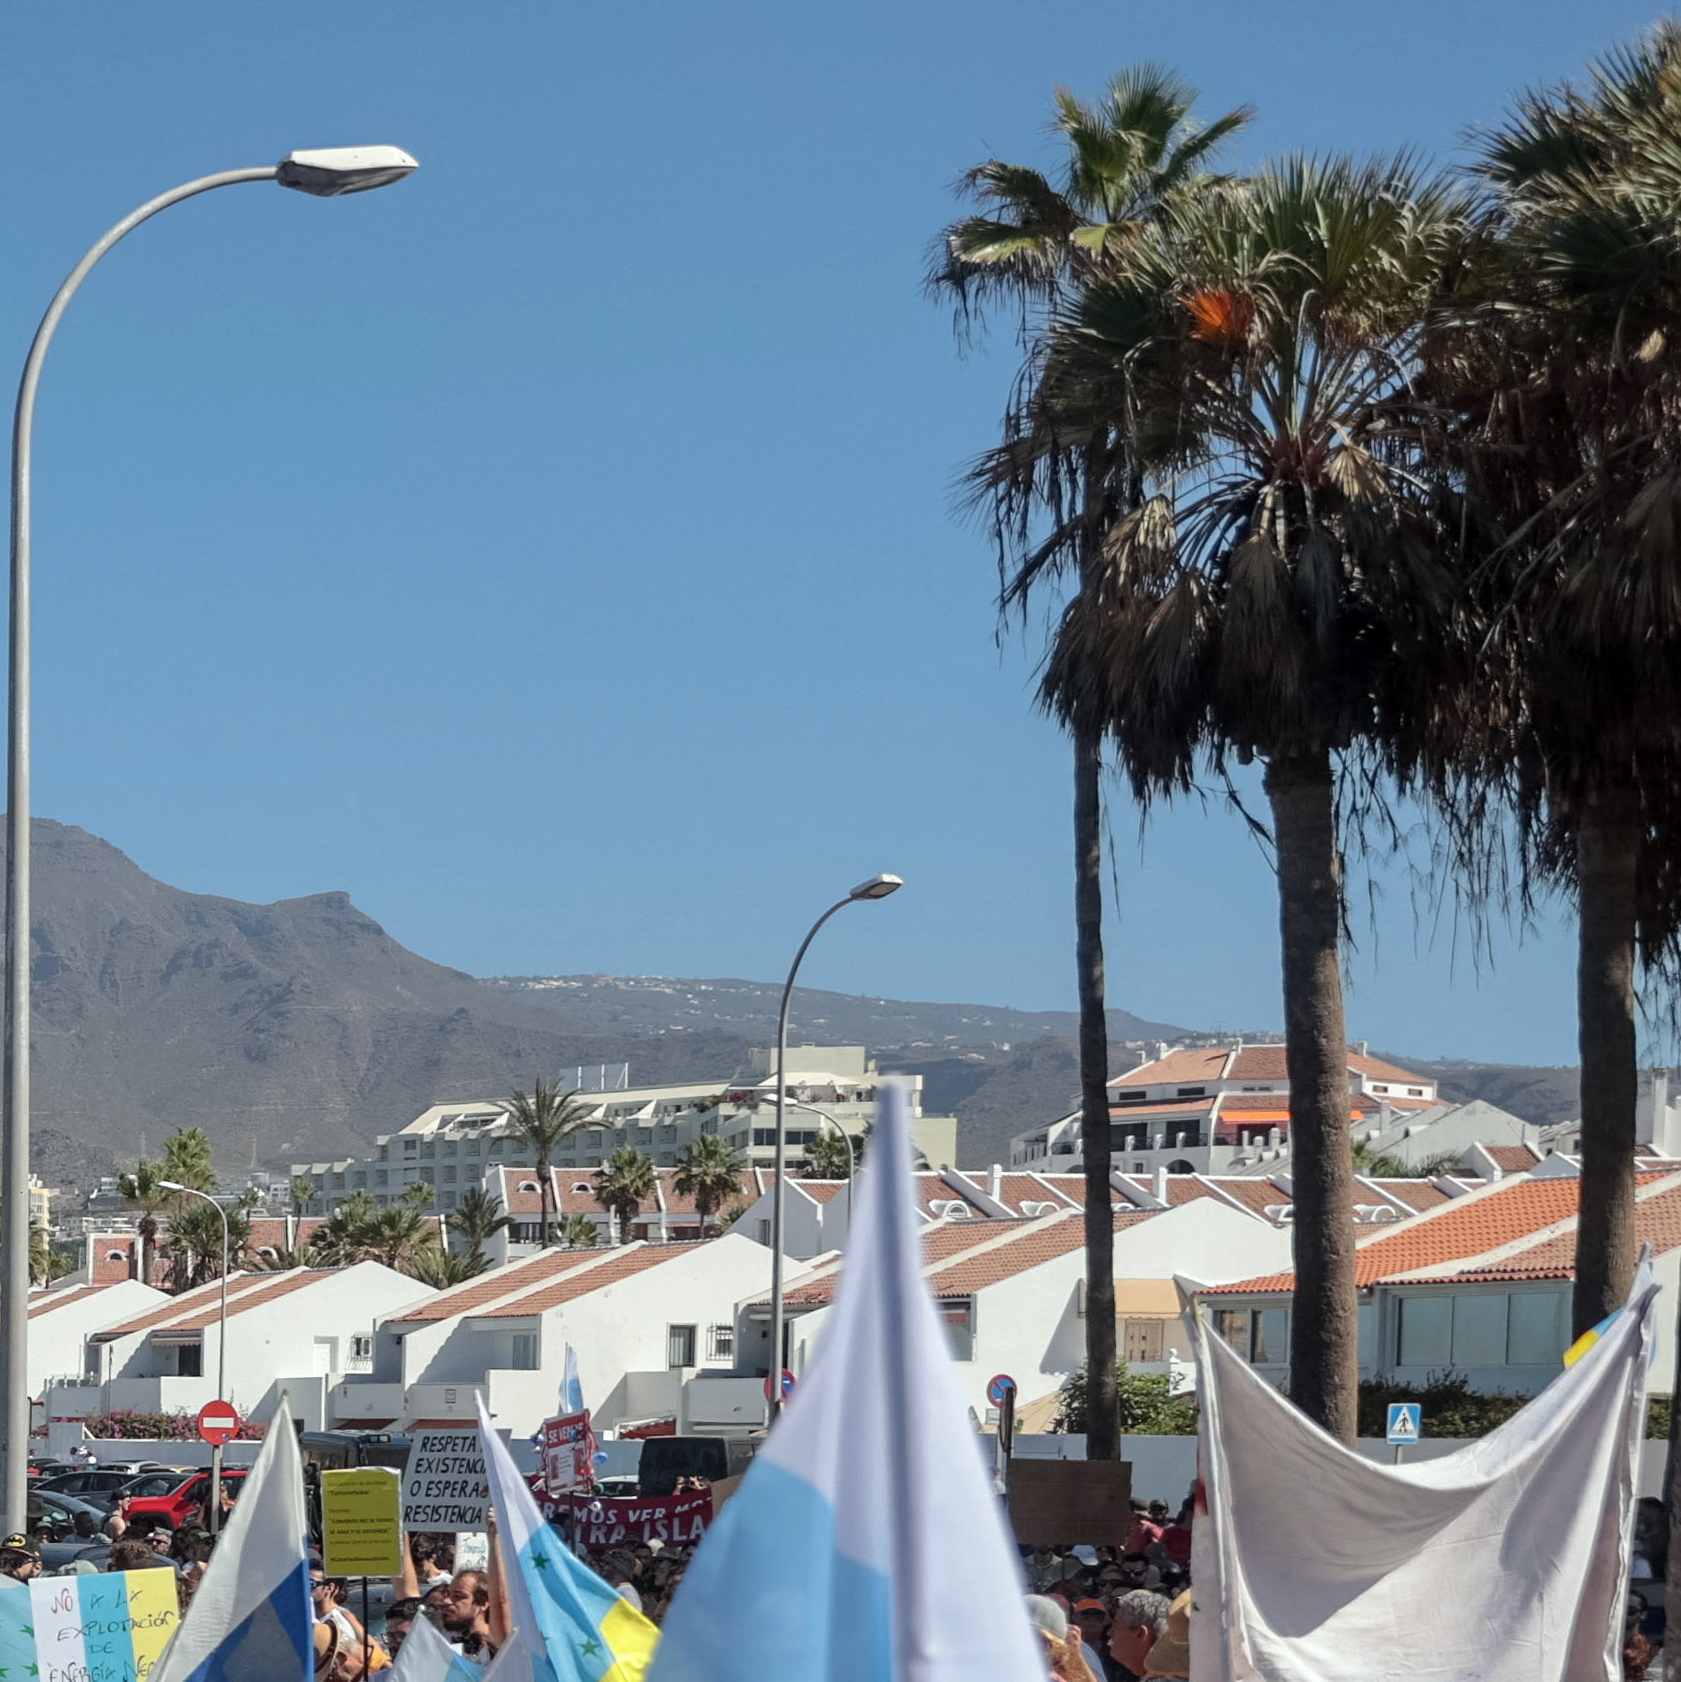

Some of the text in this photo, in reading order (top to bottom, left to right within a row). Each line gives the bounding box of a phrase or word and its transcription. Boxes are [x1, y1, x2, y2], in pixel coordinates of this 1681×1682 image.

[420, 1435, 476, 1452] RESPETA
[548, 1429, 558, 1444] SE
[410, 1480, 480, 1498] O ESPERA
[404, 1505, 482, 1524] RESISTENCIA
[51, 1588, 143, 1614] NO A LA
[90, 1642, 114, 1654] DE
